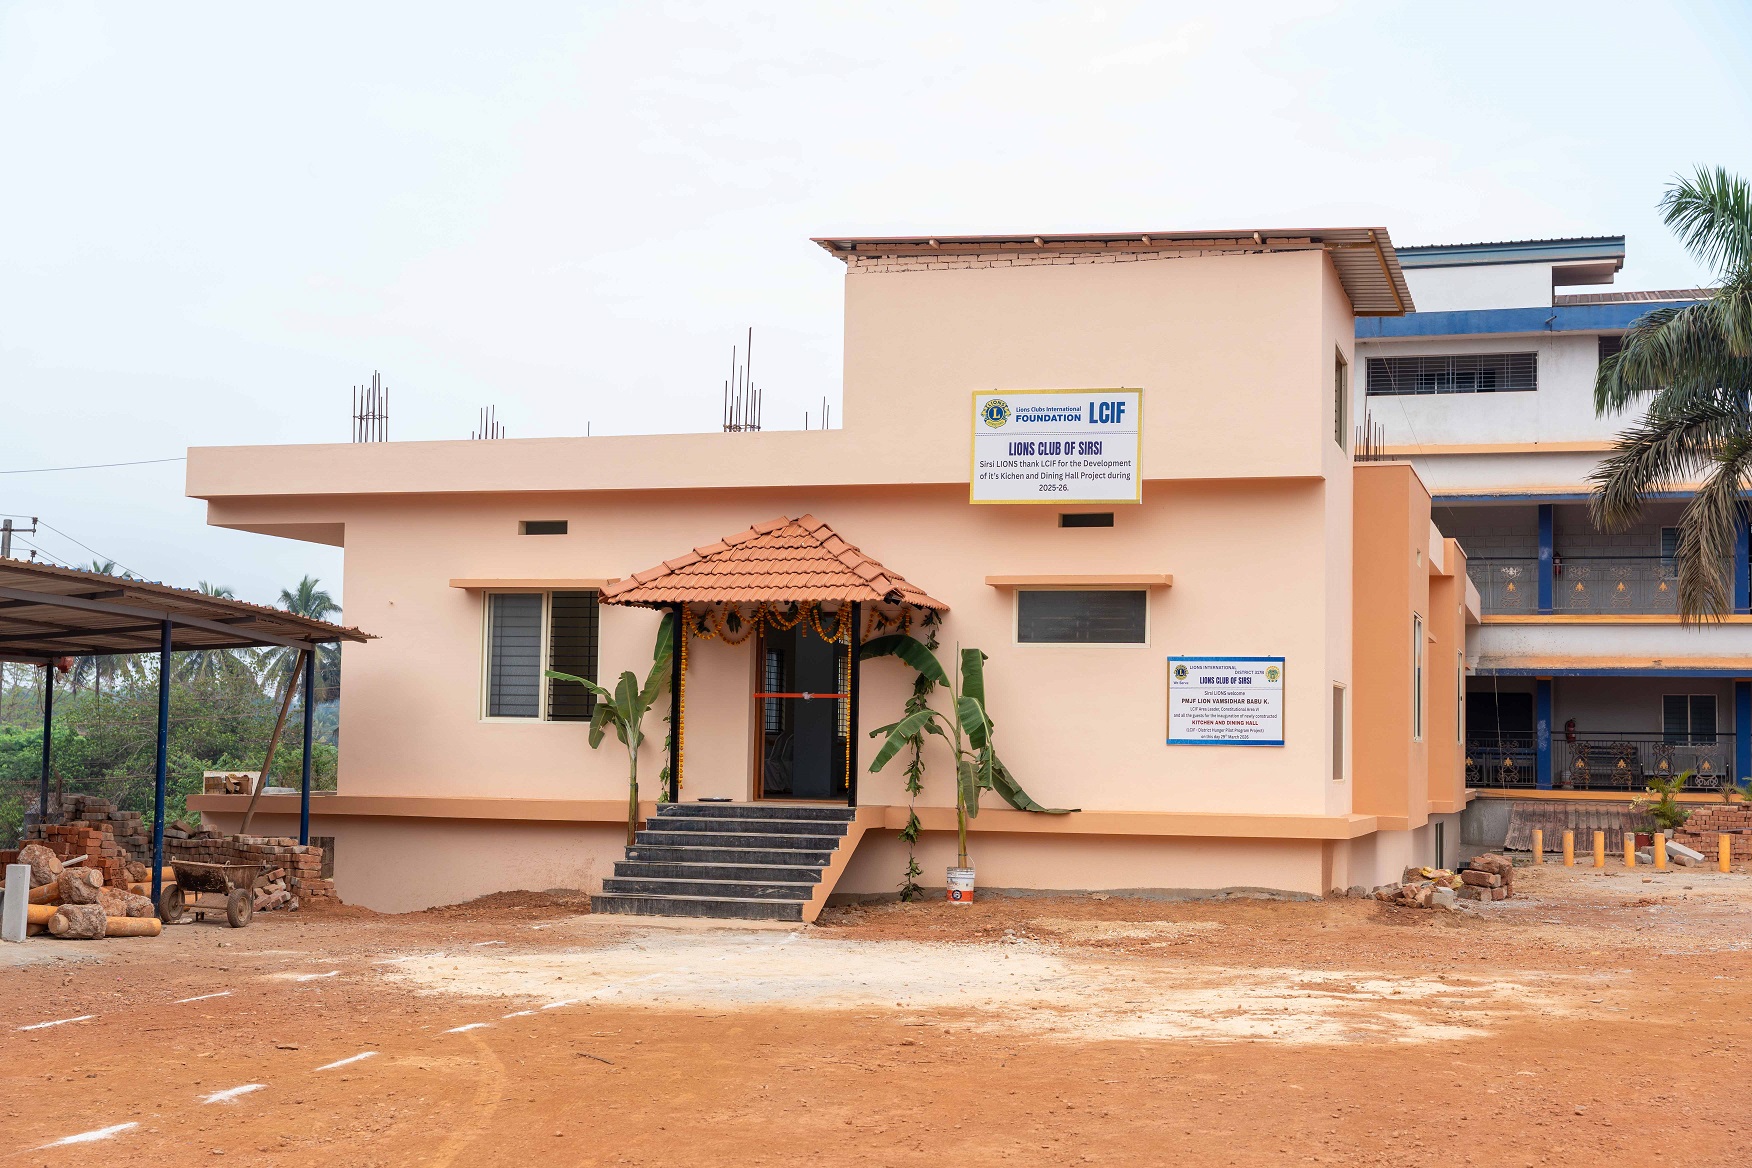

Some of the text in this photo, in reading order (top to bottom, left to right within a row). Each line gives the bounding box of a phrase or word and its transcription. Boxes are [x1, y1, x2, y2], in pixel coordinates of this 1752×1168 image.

[1089, 402, 1125, 423] LCIF
[1009, 441, 1102, 456] LIONS CLUB OF SIRSI
[1083, 460, 1131, 468] Development
[1041, 472, 1063, 481] Dining
[1108, 472, 1130, 480] during
